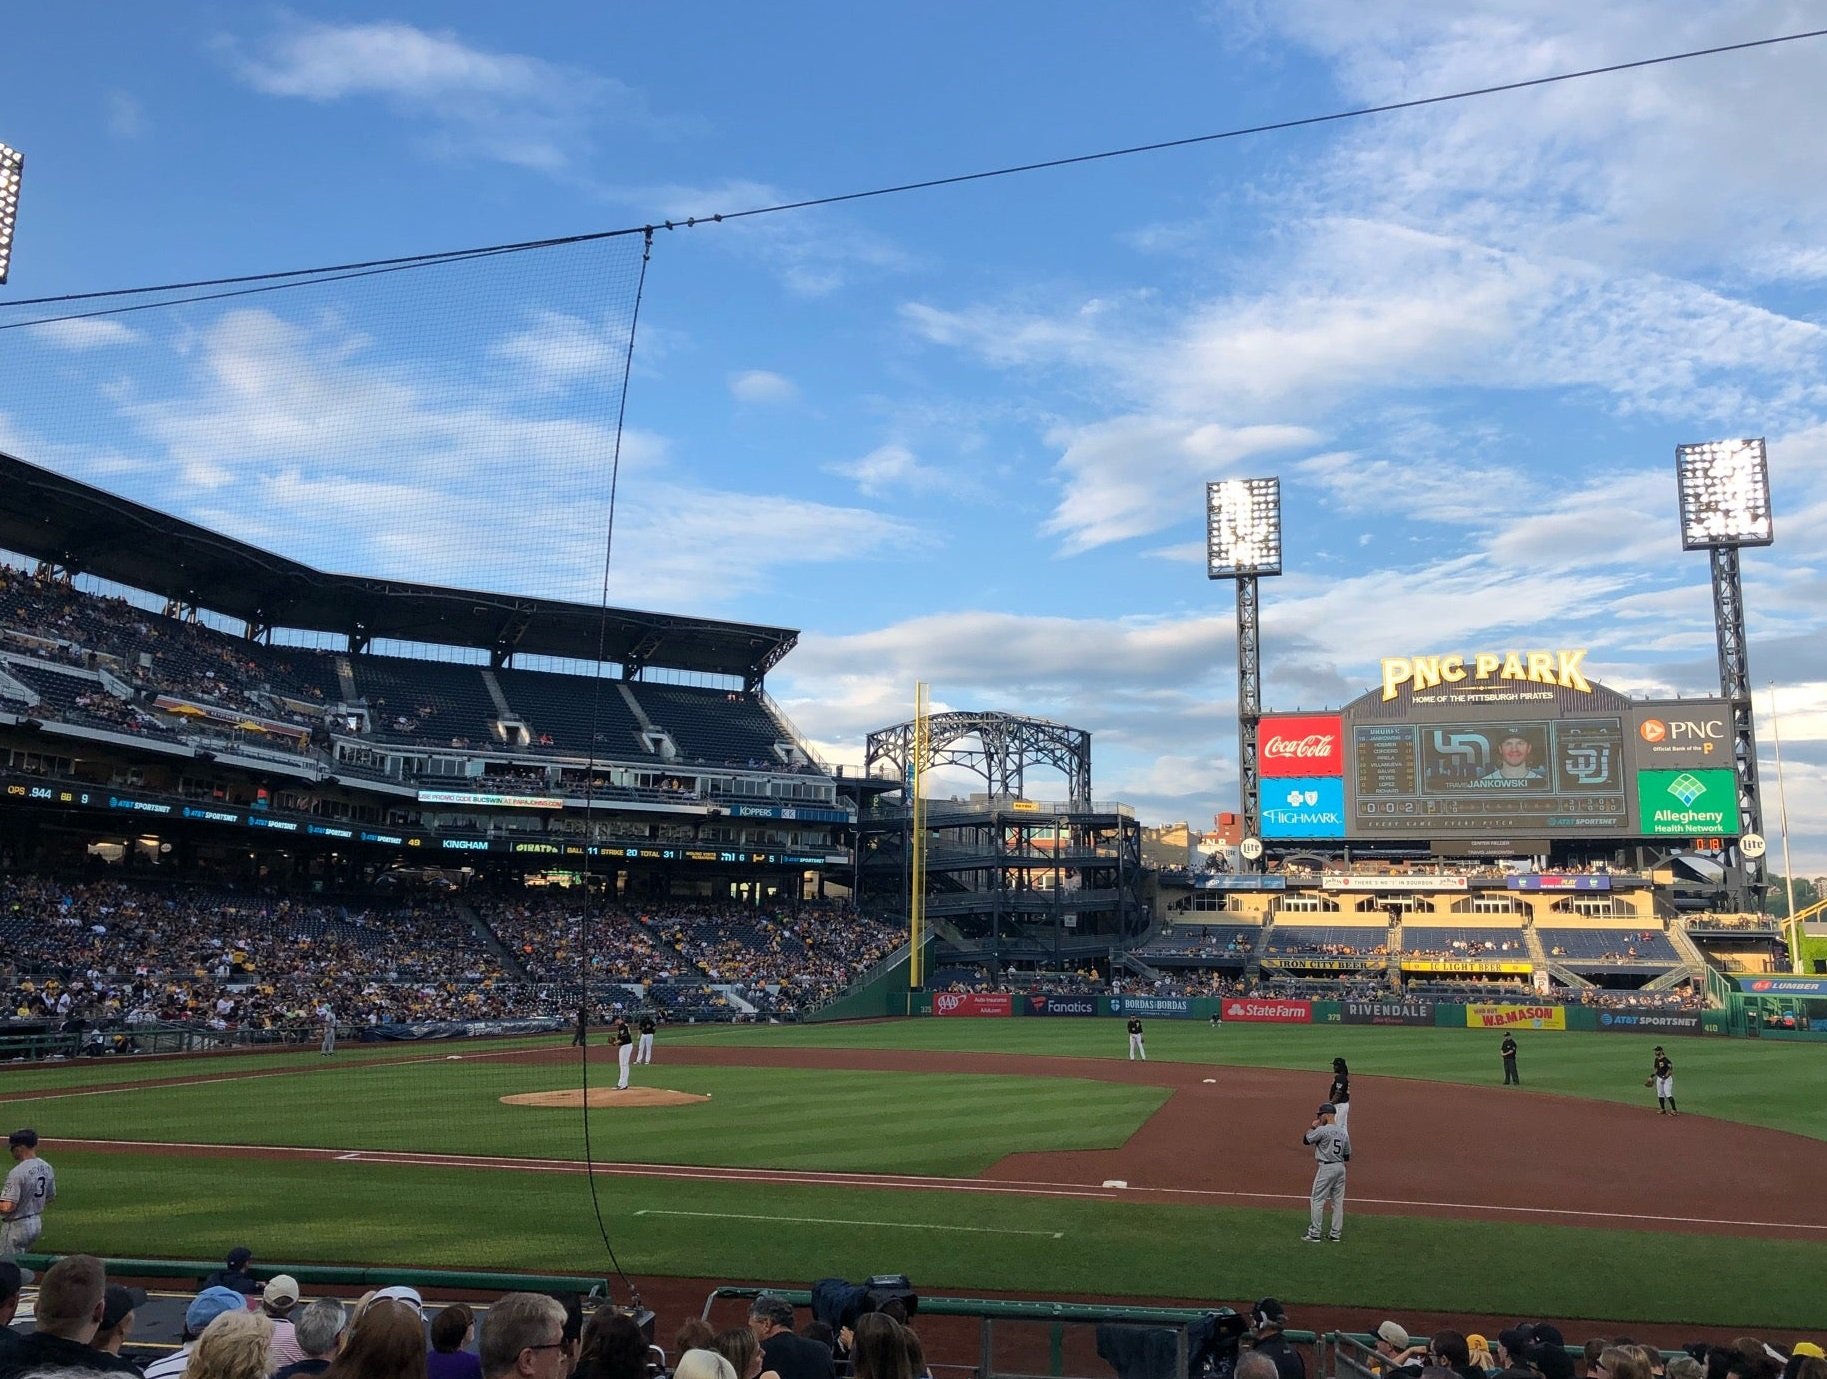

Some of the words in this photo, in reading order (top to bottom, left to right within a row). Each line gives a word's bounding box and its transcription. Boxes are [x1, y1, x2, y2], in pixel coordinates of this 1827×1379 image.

[1381, 655, 1468, 702] PNC
[1475, 649, 1592, 694] PARK
[1412, 696, 1435, 704] HOME
[1437, 695, 1448, 703] OF
[1468, 693, 1518, 701] PITTSBURGH
[1520, 692, 1554, 700] PIRATES
[1668, 721, 1724, 739] PNC
[1468, 779, 1528, 789] JANKOWSKI
[8, 785, 25, 796] OPS
[29, 787, 52, 799] .944
[472, 796, 502, 804] BUCSWIN
[134, 802, 171, 813] SPORTSNET
[740, 806, 772, 817] KOPPERS
[1367, 803, 1376, 813] 0
[1386, 803, 1394, 813] 0
[1405, 802, 1414, 812] 2
[205, 812, 237, 822] SPORTSNET
[1263, 809, 1341, 824] HIGHMARK
[1654, 810, 1723, 823] Allegheny
[1655, 824, 1681, 832] Health
[1686, 824, 1723, 832] Network
[408, 839, 420, 847] 49
[1243, 843, 1260, 854] Lite
[1743, 839, 1763, 851] Lite
[443, 840, 488, 850] KINGHAM
[601, 848, 624, 856] STRIKE
[626, 849, 638, 857] 20
[663, 850, 674, 858] 31
[1280, 960, 1305, 969] IRON
[1310, 961, 1335, 969] CITY
[1338, 961, 1367, 970] BEER
[1443, 962, 1475, 971] LIGHT
[1480, 963, 1502, 972] BEER
[940, 996, 957, 1008] AAA
[1048, 1000, 1093, 1012] Fanatics
[1125, 999, 1154, 1009] BORDAS
[1157, 1000, 1187, 1010] BORDAS
[1246, 1004, 1275, 1016] State
[1276, 1005, 1305, 1017] Farm
[1349, 1004, 1427, 1017] RIVENDALE
[1614, 1016, 1638, 1024] AT&T
[1639, 1017, 1697, 1027] SPORTSNET
[1704, 1024, 1718, 1032] 410
[1333, 1139, 1341, 1154] 5
[34, 1176, 45, 1198] 3
